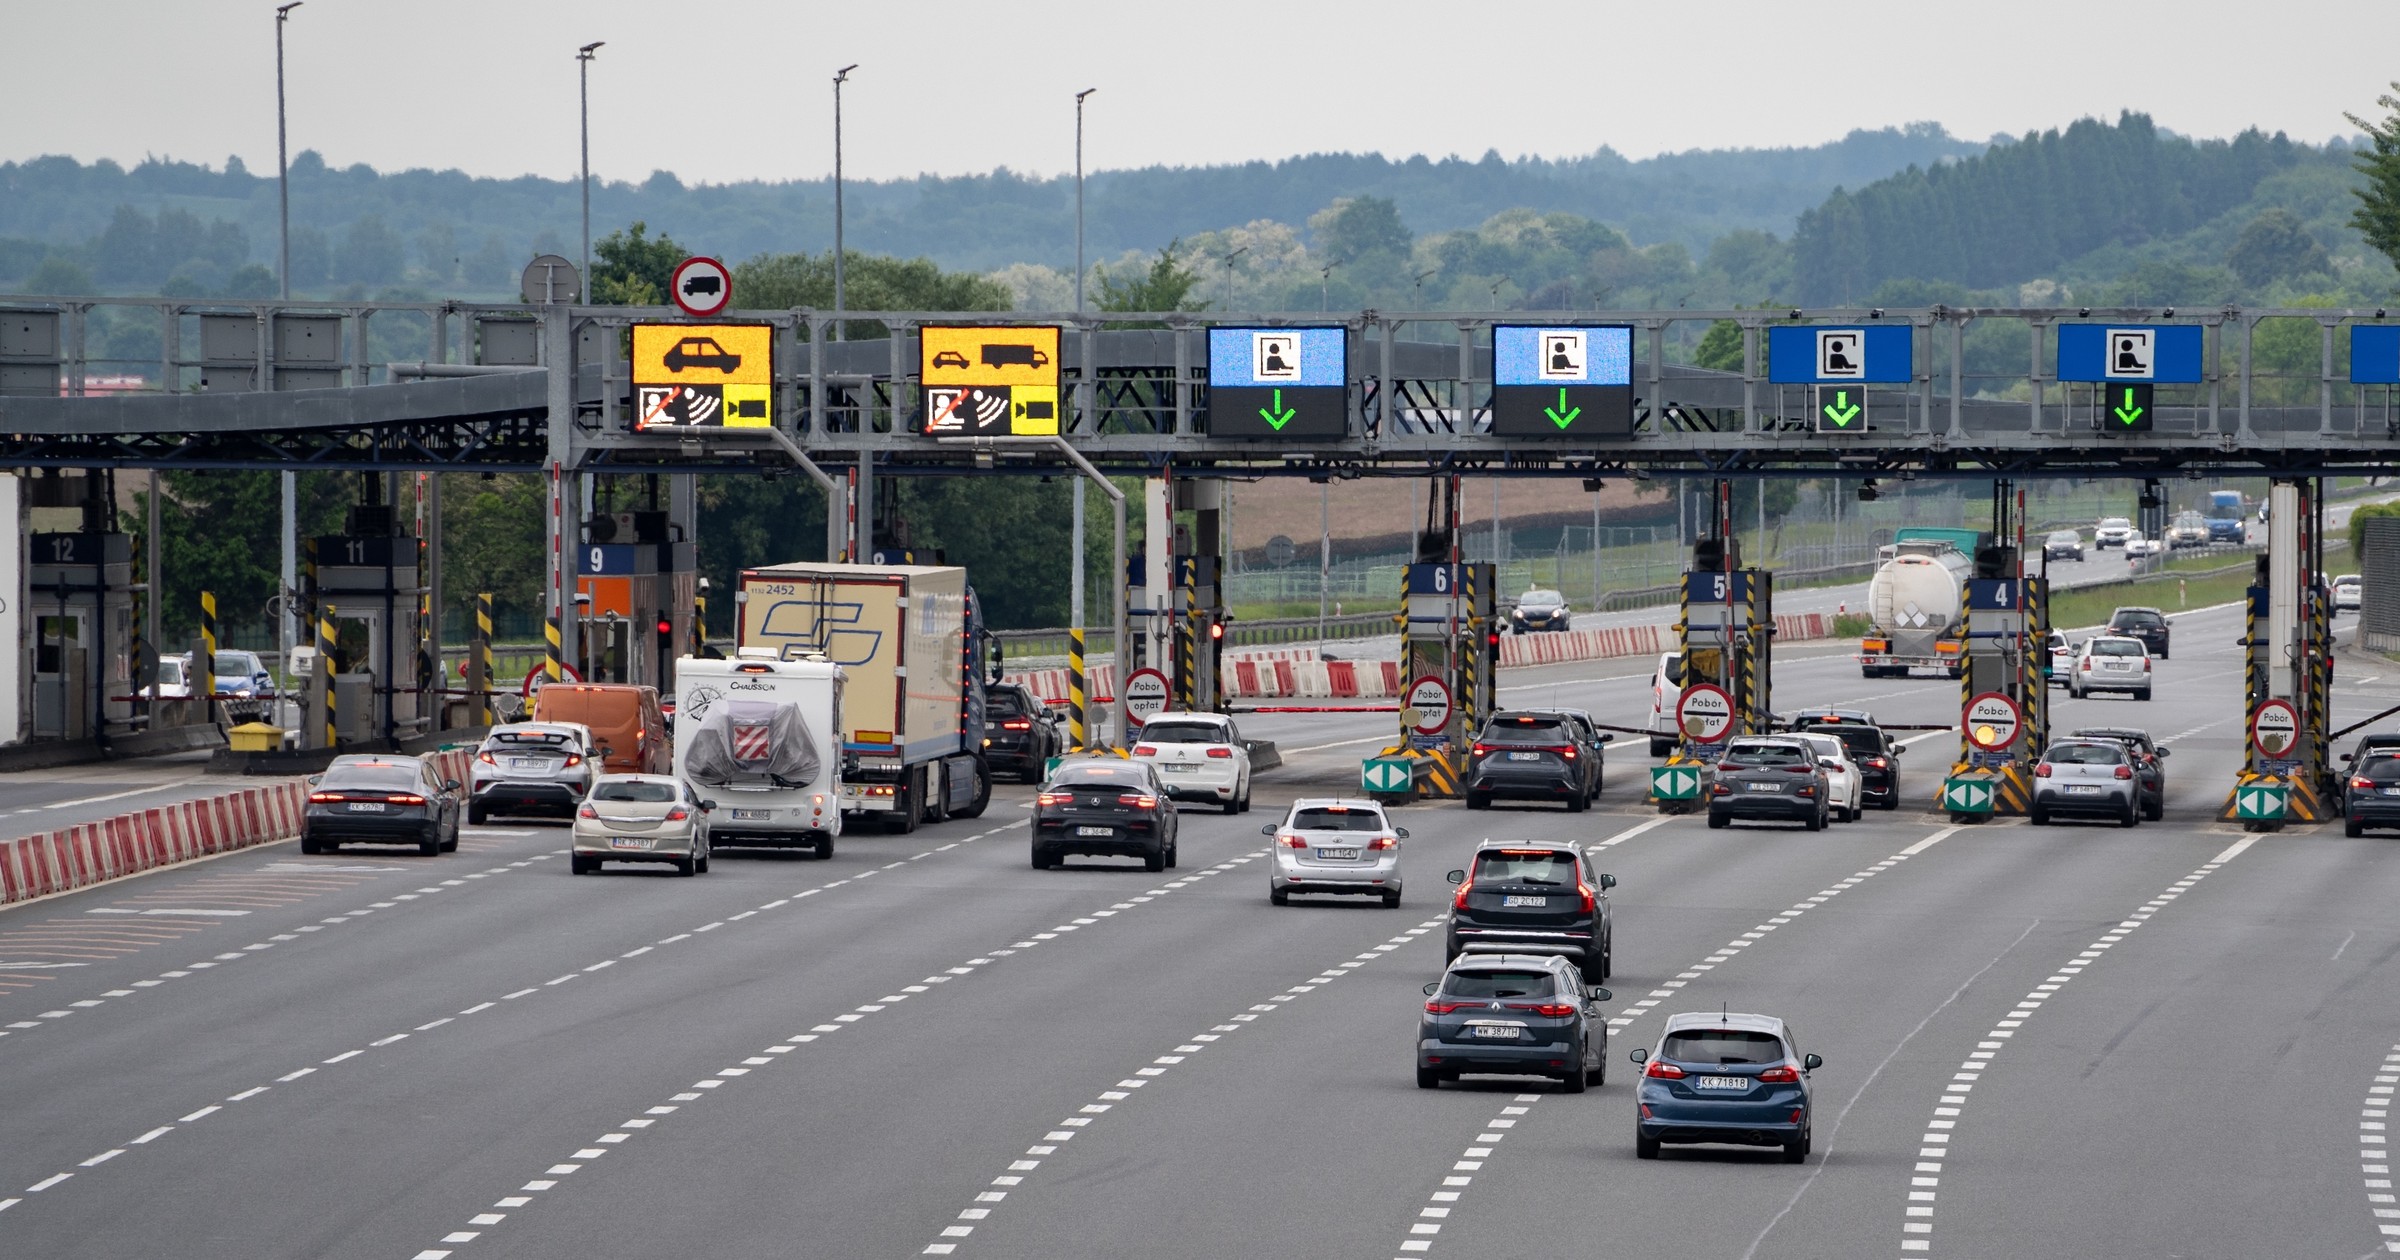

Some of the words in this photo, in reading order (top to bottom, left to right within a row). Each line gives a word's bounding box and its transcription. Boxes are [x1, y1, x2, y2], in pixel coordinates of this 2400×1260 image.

[51, 537, 74, 561] 12
[345, 540, 364, 563] 11
[590, 547, 603, 572] 9
[1434, 566, 1447, 592] 6
[766, 584, 795, 595] 2452
[1713, 575, 1725, 599] 5
[1994, 582, 2008, 607] 4
[2308, 590, 2318, 614] 3
[1134, 682, 1159, 691] Pobór
[1417, 689, 1442, 699] Pobór
[1134, 701, 1159, 712] opłat
[1691, 697, 1722, 708] Pobór
[1978, 705, 2008, 715] Pobór
[2263, 713, 2288, 722] Pobór
[351, 802, 360, 811] KK
[1508, 896, 1518, 904] GD
[1521, 897, 1544, 905] 2C122
[1477, 1027, 1488, 1035] WW
[1491, 1027, 1518, 1036] 387TH
[1701, 1077, 1713, 1086] KK
[1717, 1077, 1745, 1087] 71818
